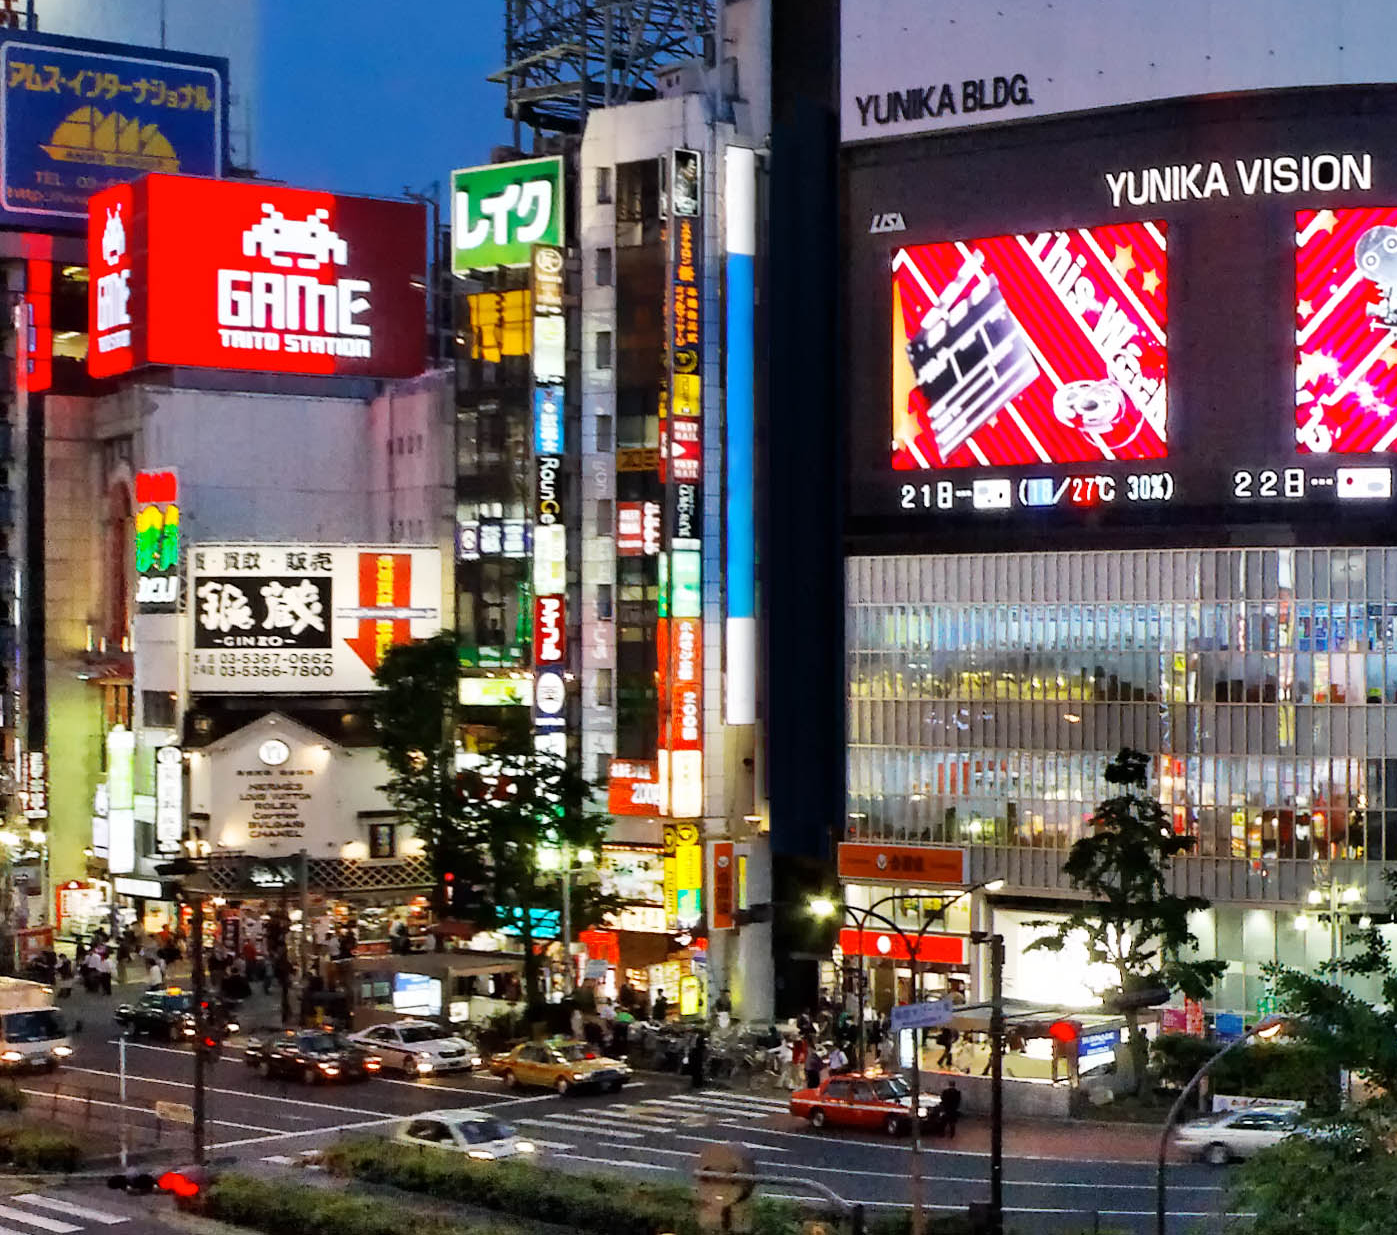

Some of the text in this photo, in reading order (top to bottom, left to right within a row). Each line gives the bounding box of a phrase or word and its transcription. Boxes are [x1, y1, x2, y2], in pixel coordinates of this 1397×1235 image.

[8, 61, 213, 112] アムス・インターナショナル
[856, 73, 1034, 126] YUNIKA BLDG.
[1106, 153, 1372, 208] YUNIKA VISION
[455, 179, 552, 250] レイク
[217, 269, 371, 336] GAME
[217, 329, 371, 358] TAITO STATION
[197, 579, 326, 635] 銀蔵
[540, 597, 561, 661] アイフル
[220, 653, 333, 664] 03-5367-0662
[220, 666, 333, 677] 03-5366-7800
